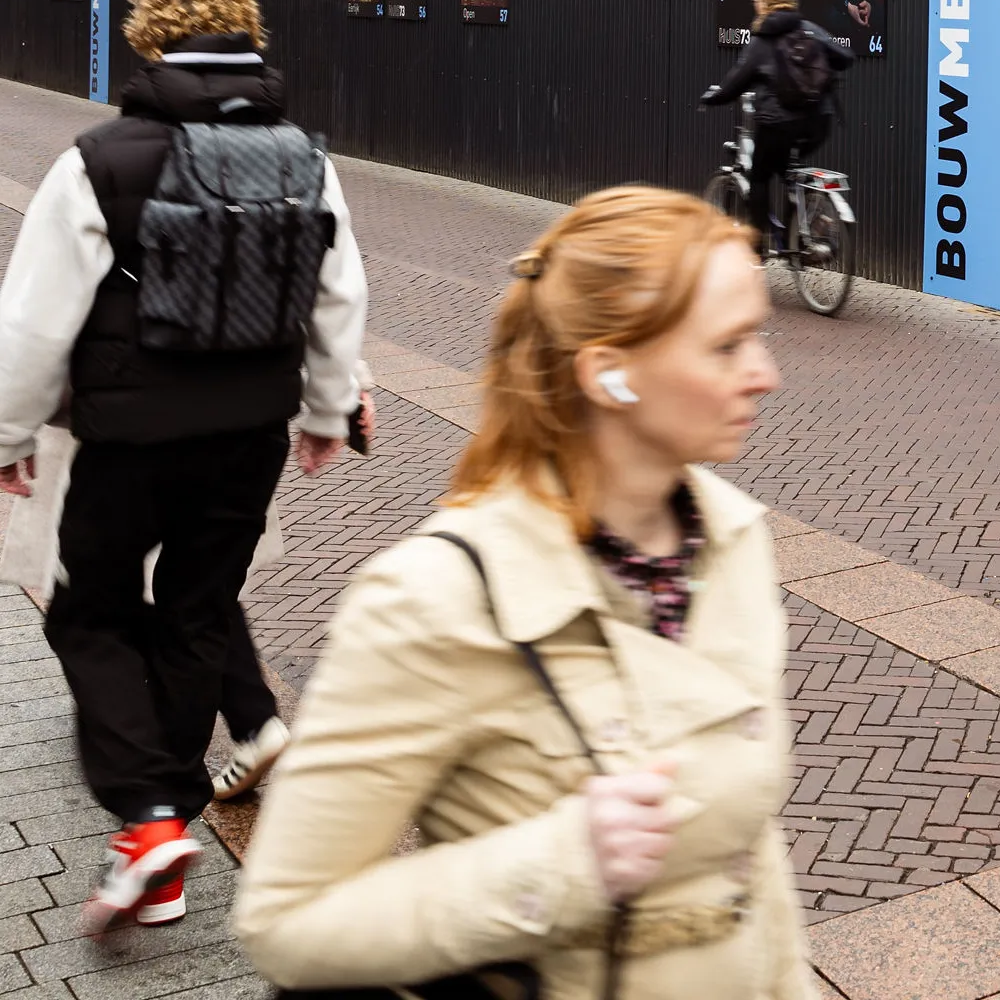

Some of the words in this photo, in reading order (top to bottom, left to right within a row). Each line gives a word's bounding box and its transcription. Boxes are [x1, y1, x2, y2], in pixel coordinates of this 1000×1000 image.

[499, 9, 508, 22] 57
[718, 28, 750, 44] HUIS73
[869, 36, 883, 53] 64
